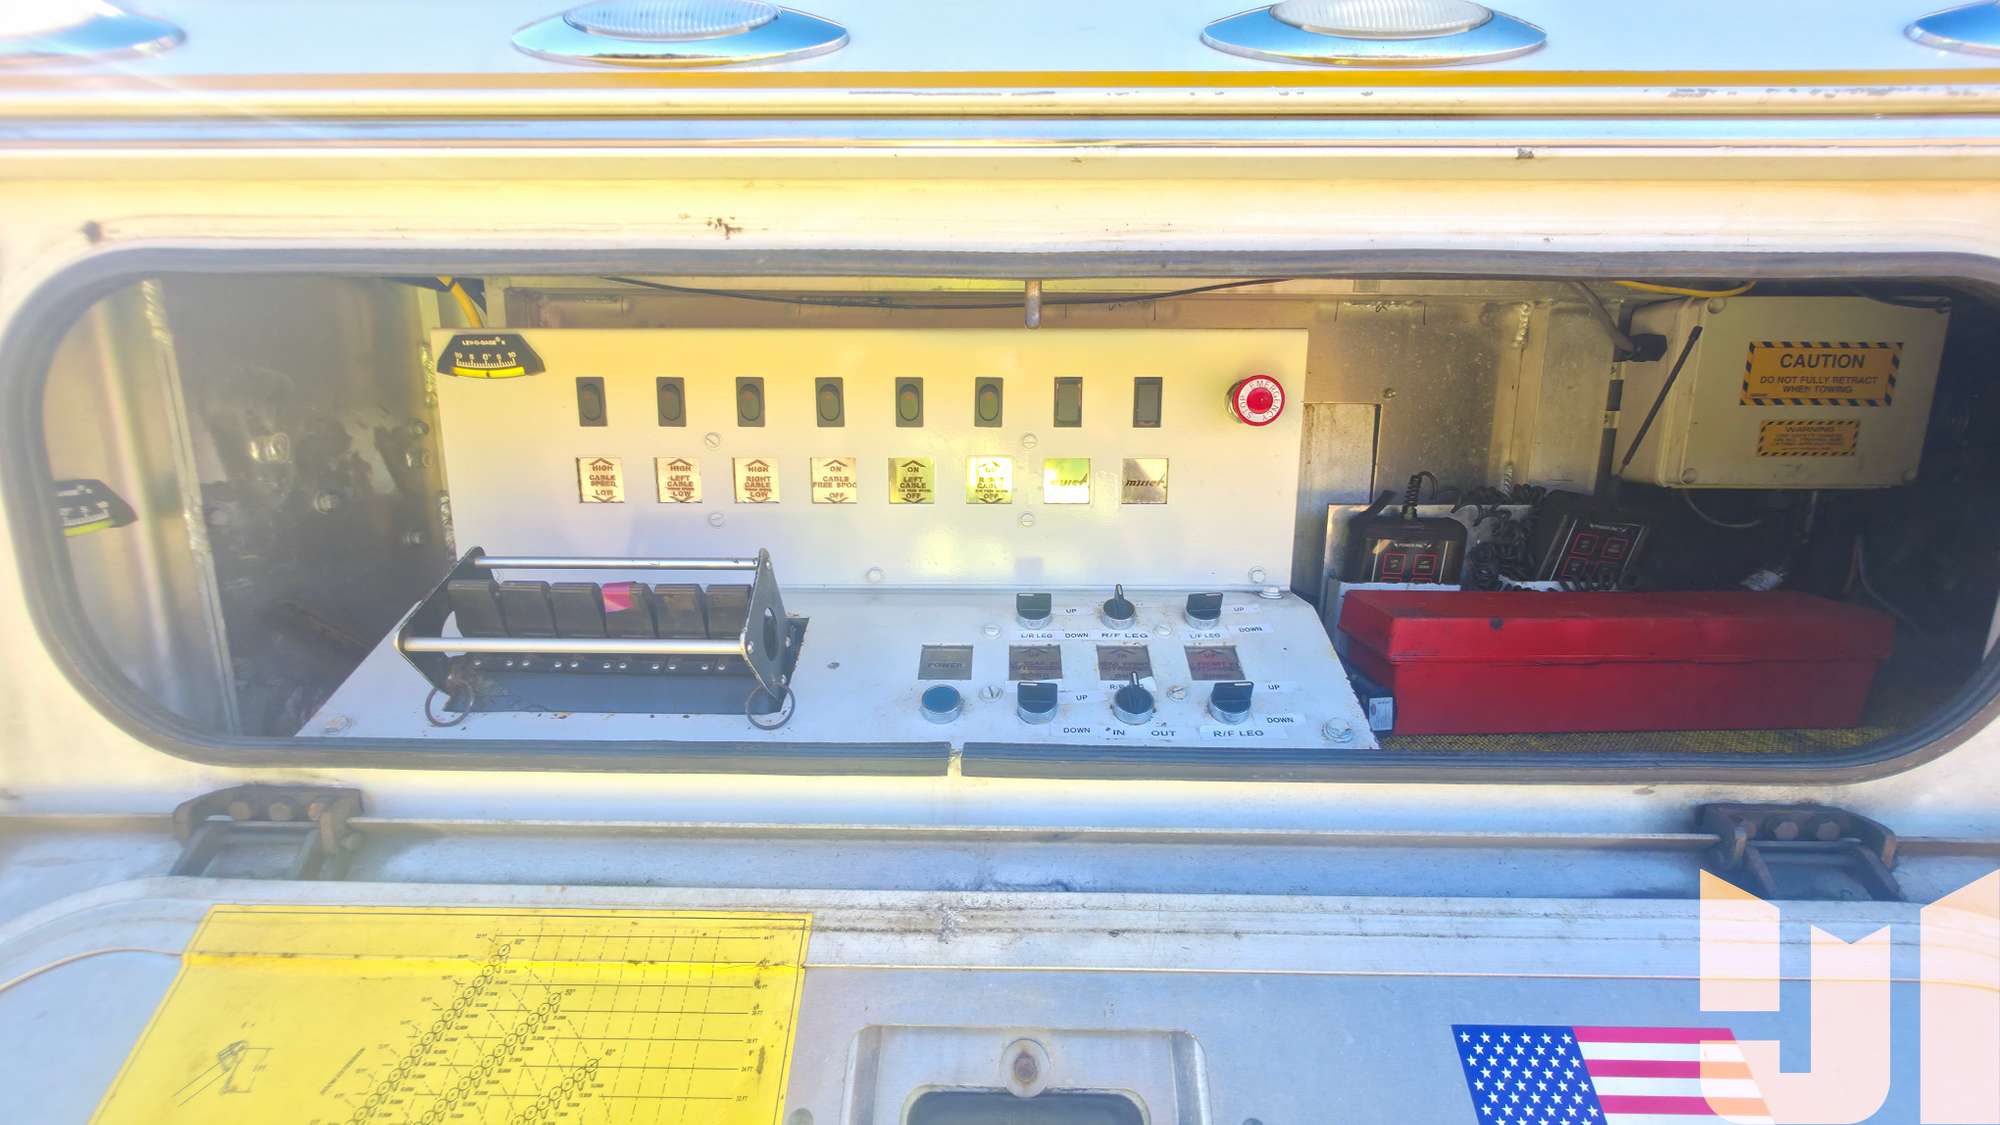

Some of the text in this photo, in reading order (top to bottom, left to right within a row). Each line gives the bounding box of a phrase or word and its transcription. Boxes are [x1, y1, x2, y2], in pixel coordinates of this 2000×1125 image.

[1780, 353, 1865, 369] CAUTION
[1760, 376, 1878, 385] DO NOT FULLY RETRACT
[1266, 716, 1295, 724] DOWN
